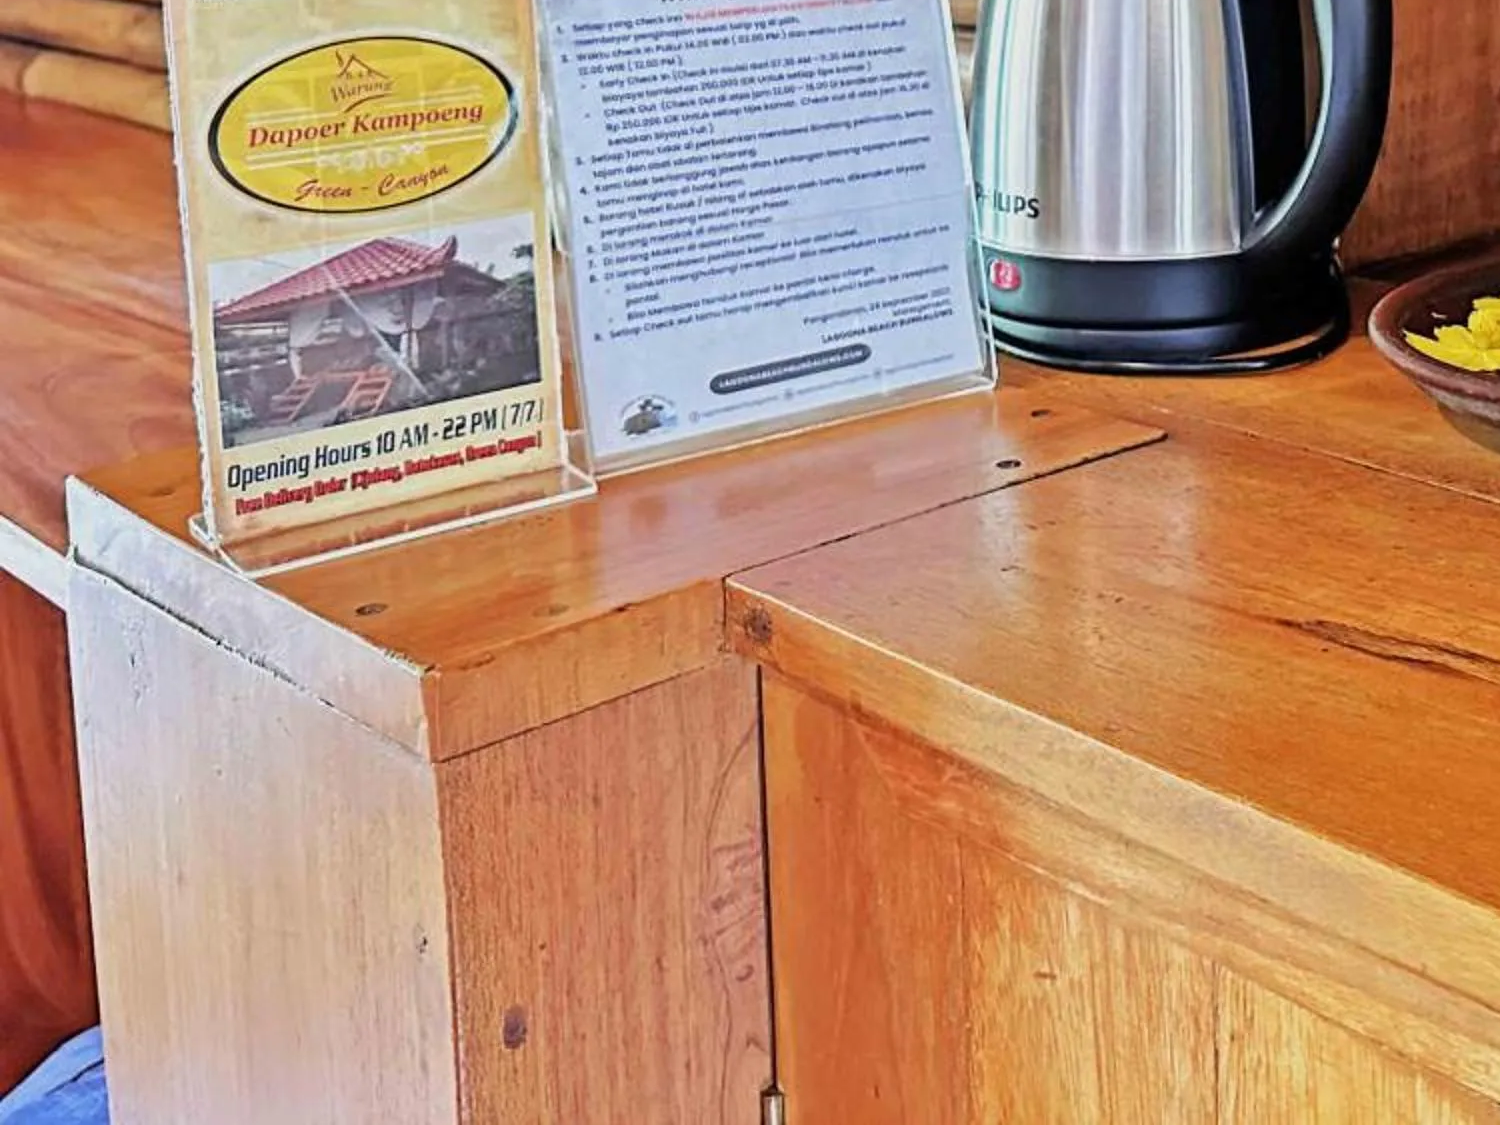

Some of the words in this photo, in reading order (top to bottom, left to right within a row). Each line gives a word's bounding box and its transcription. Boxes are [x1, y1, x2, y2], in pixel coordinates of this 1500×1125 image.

[329, 78, 394, 104] Warung
[248, 116, 346, 150] Dapoer
[352, 103, 484, 135] Kampoeng
[293, 178, 353, 202] Green
[377, 164, 451, 197] Canyon
[227, 452, 310, 492] Opening
[315, 441, 371, 469] Hours
[375, 432, 395, 455] 10
[399, 423, 429, 450] AM
[442, 416, 467, 441] 22
[470, 407, 498, 435] PM
[235, 496, 263, 515] Free
[263, 485, 313, 505] Delivery
[314, 476, 348, 497] Order
[465, 443, 498, 462] Green
